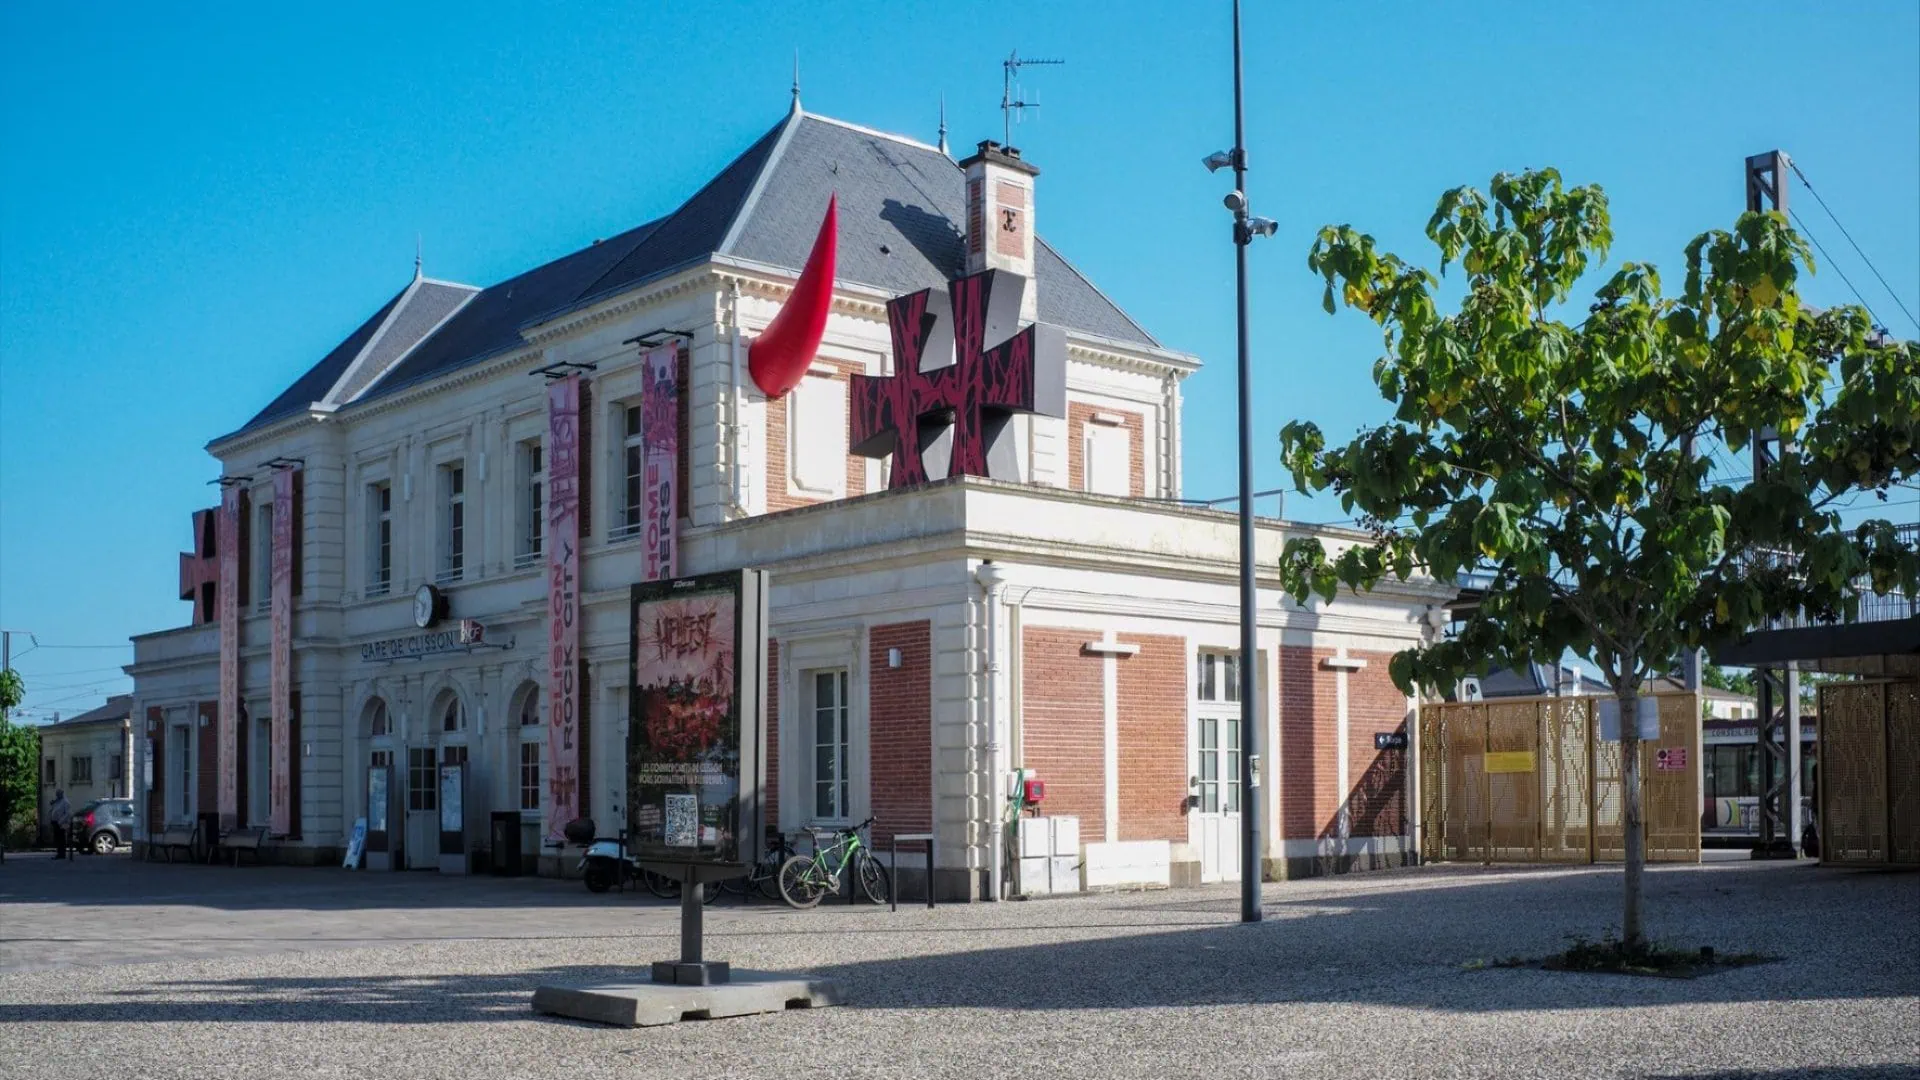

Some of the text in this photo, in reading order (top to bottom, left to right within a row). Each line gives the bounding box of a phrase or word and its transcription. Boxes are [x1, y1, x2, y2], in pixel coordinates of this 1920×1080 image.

[648, 463, 659, 579] HOME
[361, 631, 454, 658] GARE DE CLISSON
[553, 563, 563, 728] CLISSON
[563, 539, 573, 750] ROCK CITY
